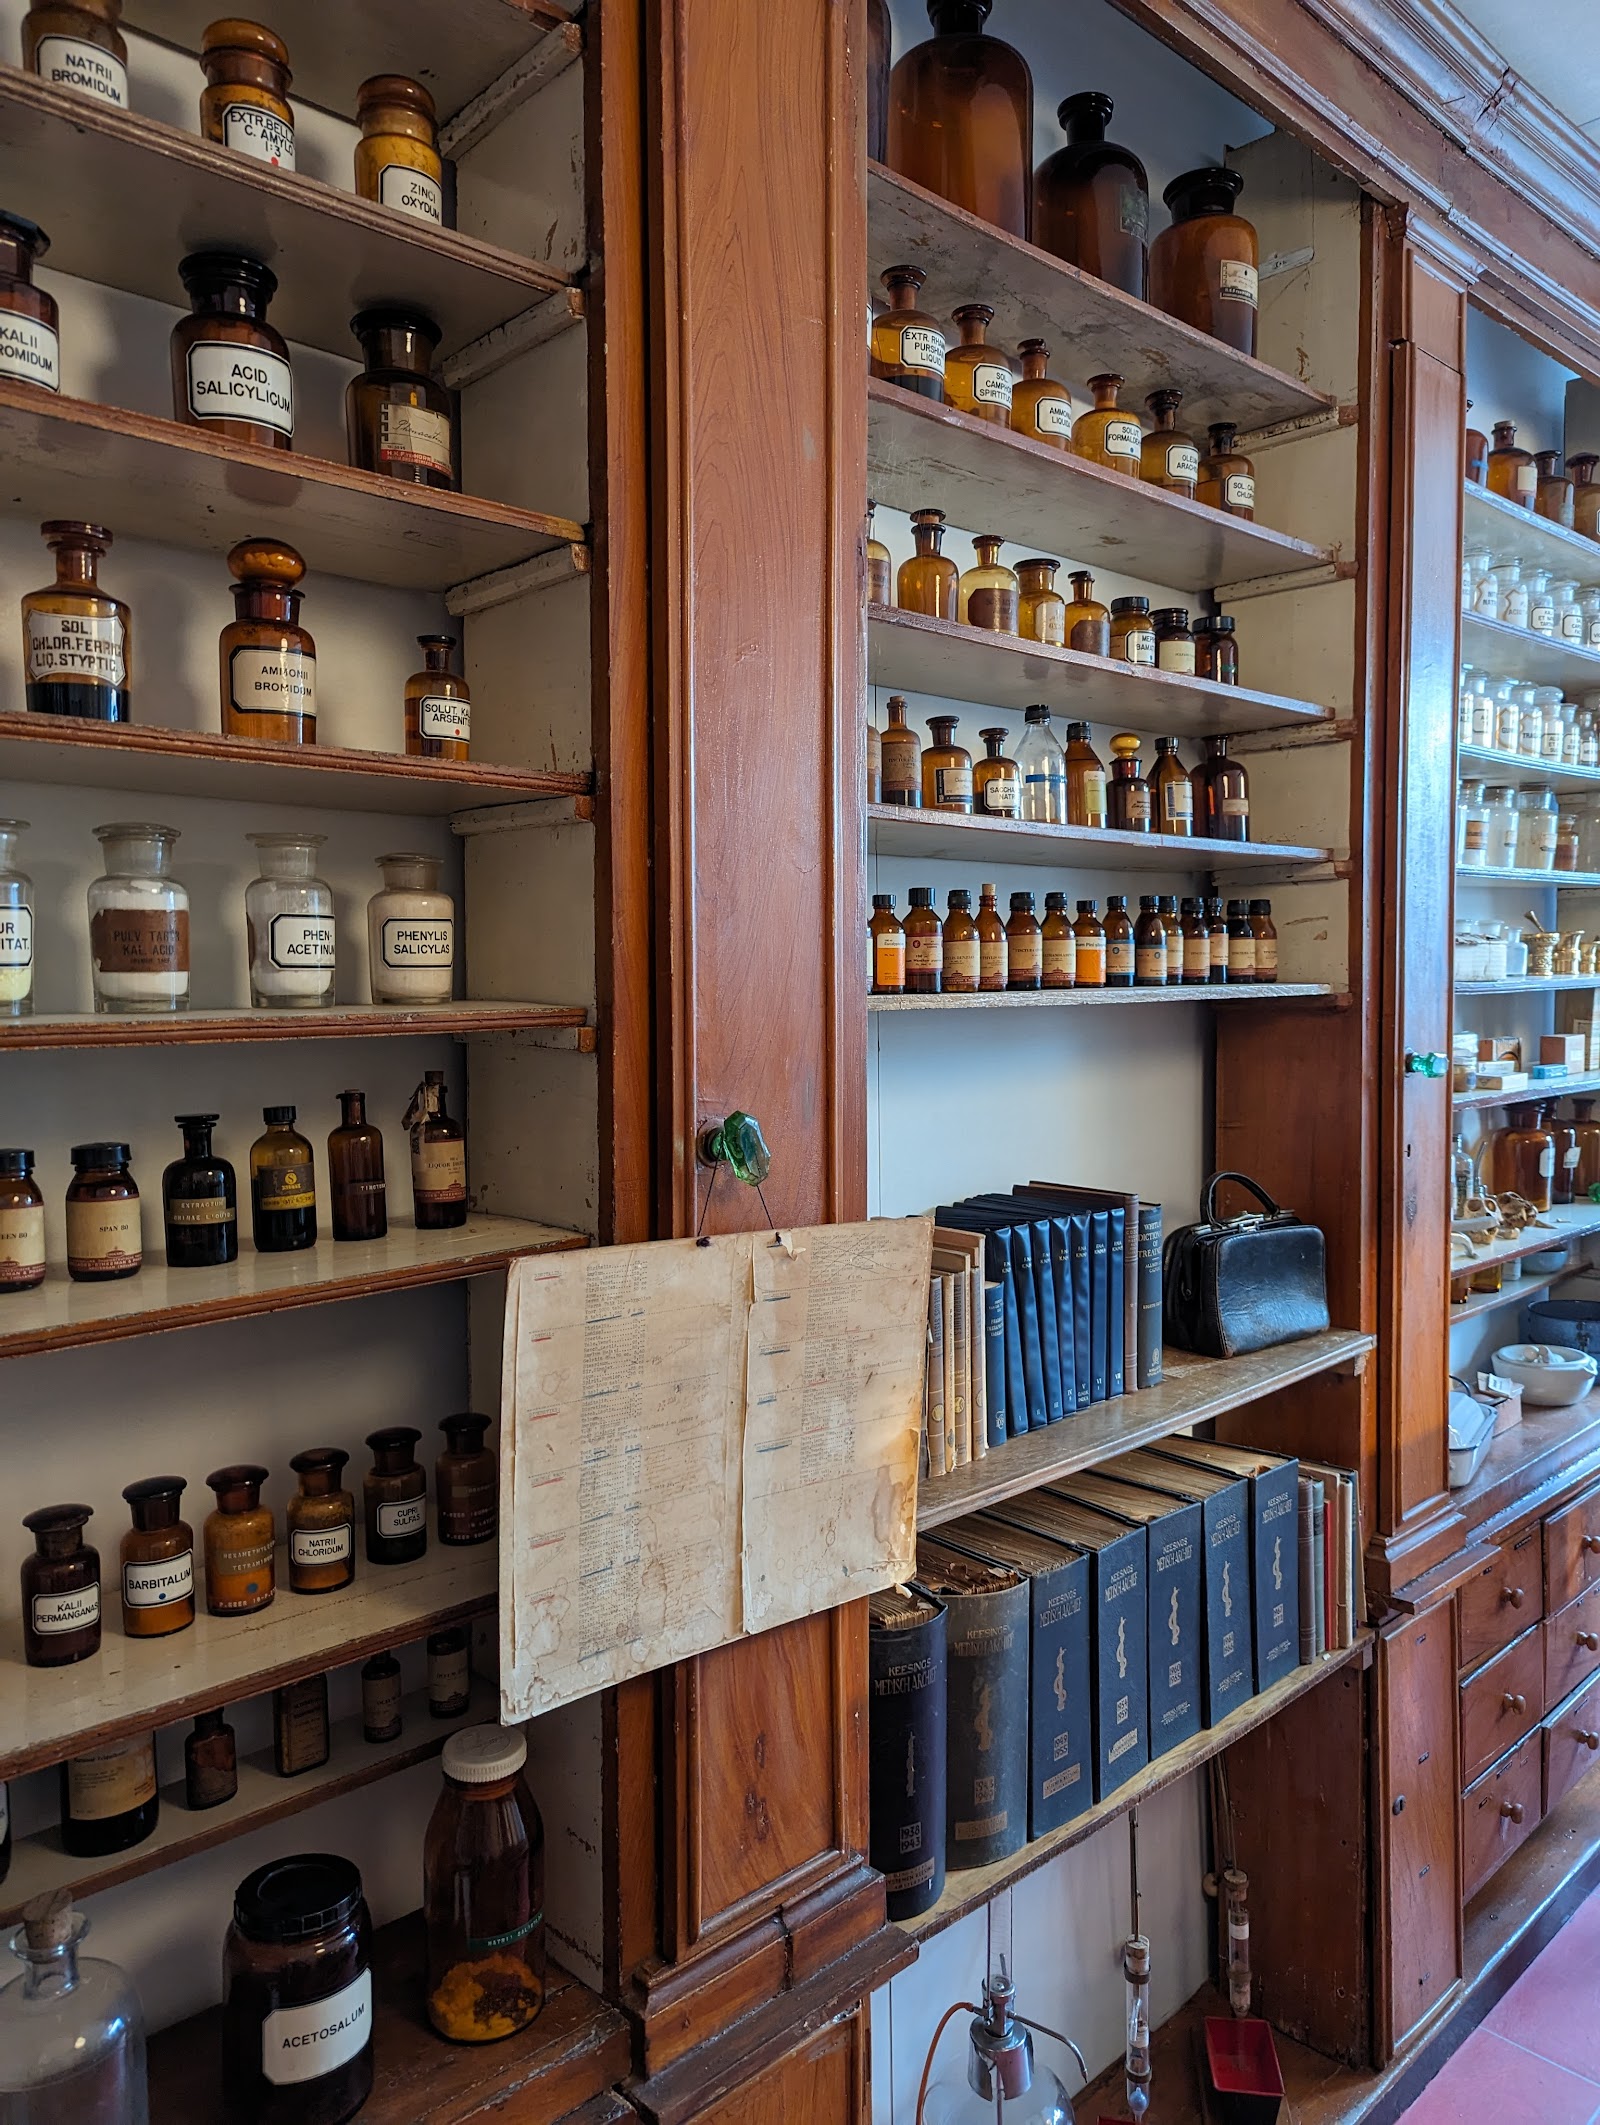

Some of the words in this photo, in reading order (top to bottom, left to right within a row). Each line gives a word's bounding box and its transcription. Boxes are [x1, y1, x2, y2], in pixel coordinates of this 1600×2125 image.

[65, 52, 113, 82] NATRII
[51, 68, 121, 104] BROMIDUM
[244, 124, 256, 137] C.
[260, 129, 293, 157] AMYLO
[410, 182, 436, 204] ZINCI
[401, 194, 440, 222] OXYDUM
[0, 326, 38, 348] KALII
[905, 331, 930, 343] EXTR.
[231, 363, 271, 386] ACID.
[196, 380, 291, 415] SALICYLICUM
[61, 619, 92, 635] SOL.
[261, 665, 309, 681] AMMONII
[254, 681, 313, 697] BROMIDUM
[424, 703, 457, 716] SOLUT.
[303, 929, 333, 941] PHEN-
[397, 930, 448, 941] PHENYLIS
[393, 944, 450, 955] SALICYLAS
[99, 1225, 119, 1233] SPAN
[393, 1513, 421, 1527] SULFAS
[397, 1506, 418, 1518] CUPRI
[308, 1537, 336, 1547] NATRII
[1162, 1537, 1188, 1554] KEESINGS
[298, 1544, 344, 1557] CHLORIDUM
[128, 1567, 192, 1590] BARBITALUM
[1110, 1563, 1134, 1583] KEESINGS
[57, 1599, 82, 1612] KALII
[1048, 1588, 1077, 1608] KEESINGS
[36, 1602, 99, 1623] PERMANGANAS
[967, 1624, 1009, 1640] KEESINGS
[954, 1640, 989, 1657] MEDISCH
[888, 1657, 932, 1677] KEESINGS
[874, 1676, 911, 1696] MEDISCH
[912, 1665, 938, 1691] ARCHIEF
[901, 1824, 920, 1840] 1938
[901, 1837, 920, 1852] 1943
[281, 2003, 365, 2049] ACETOSALUM
